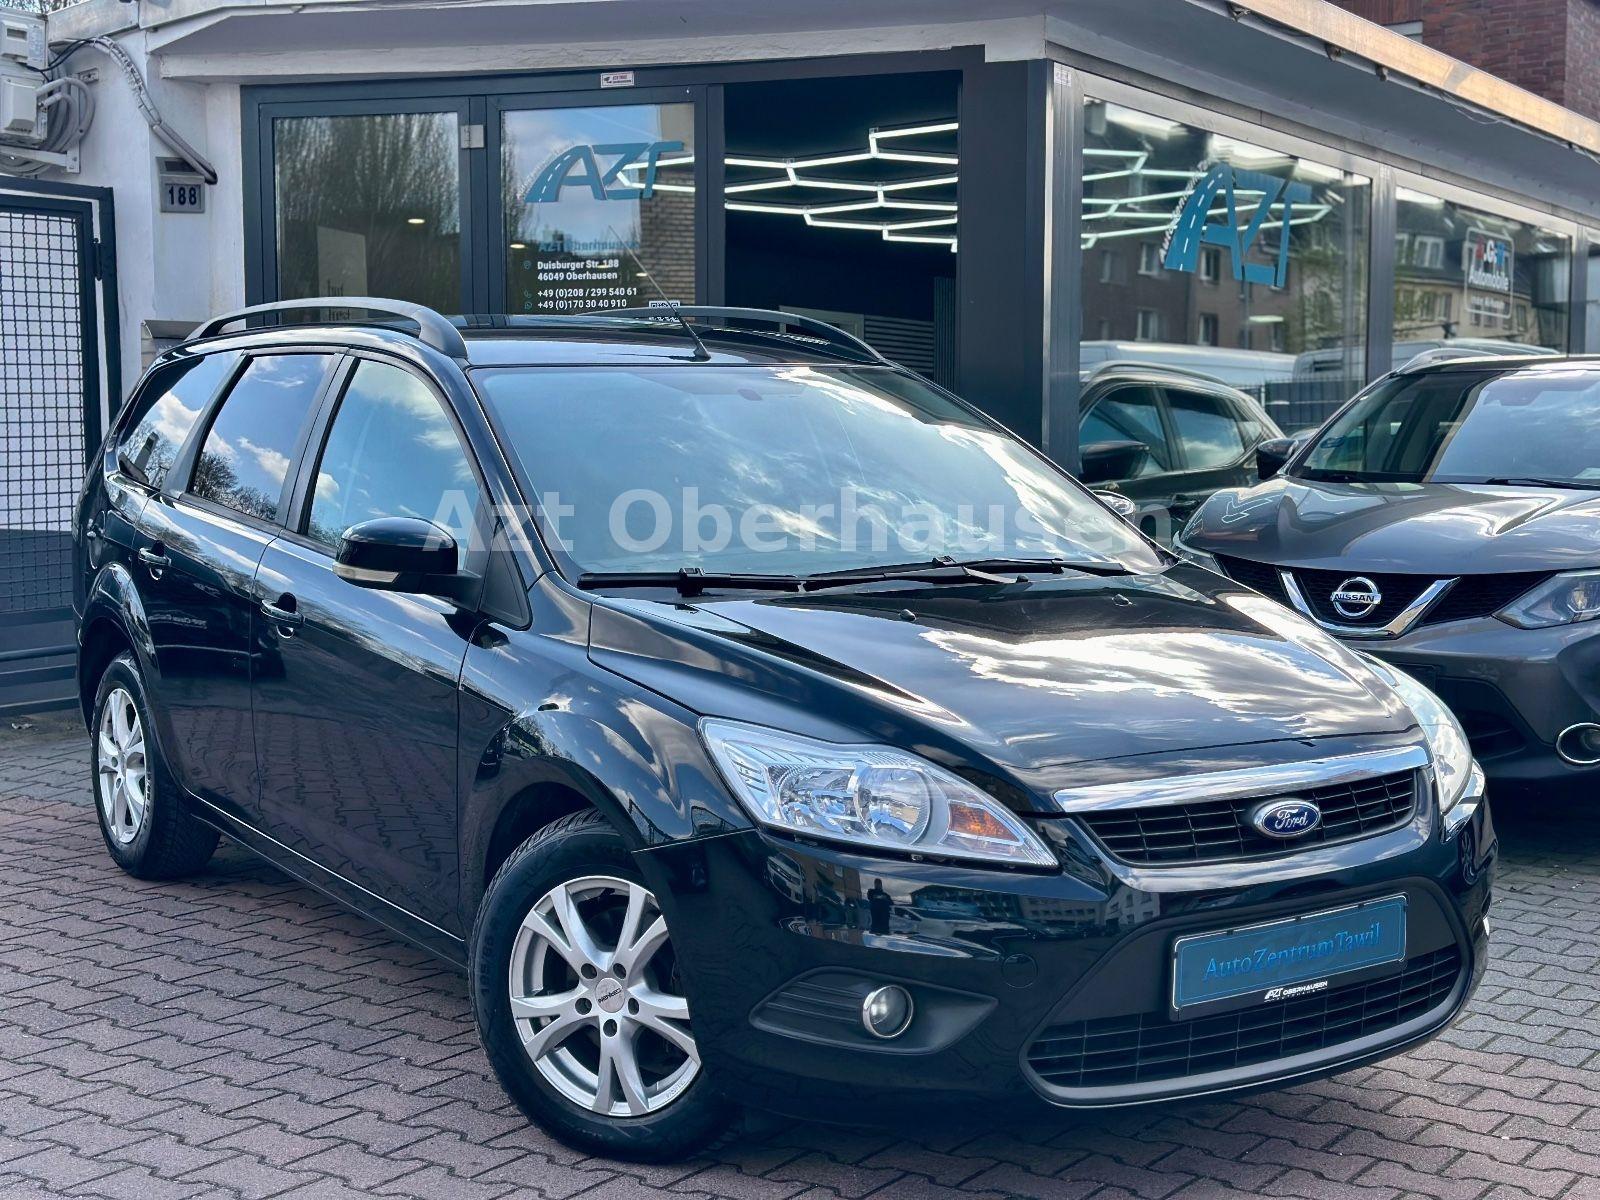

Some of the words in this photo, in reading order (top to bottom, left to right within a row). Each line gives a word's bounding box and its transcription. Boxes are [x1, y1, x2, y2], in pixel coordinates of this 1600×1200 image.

[525, 141, 685, 202] AZT
[168, 185, 197, 205] 188
[1164, 162, 1312, 288] AZT
[537, 260, 584, 270] Duisburger
[602, 259, 620, 268] 188
[537, 272, 564, 281] 46049
[566, 271, 618, 280] Oberhausen
[537, 289, 554, 298] +49
[555, 288, 584, 299] (0)208
[585, 288, 590, 297] /
[591, 288, 607, 297] 299
[609, 287, 625, 296] 540
[626, 287, 638, 296] 61
[537, 300, 554, 309] +49
[555, 300, 584, 310] (0)170
[585, 299, 597, 308] 30
[598, 299, 609, 308] 40
[611, 298, 627, 308] 910
[1333, 593, 1375, 602] NISSAN
[1274, 808, 1309, 830] Ford
[1282, 980, 1328, 996] OBERHAUSEN
